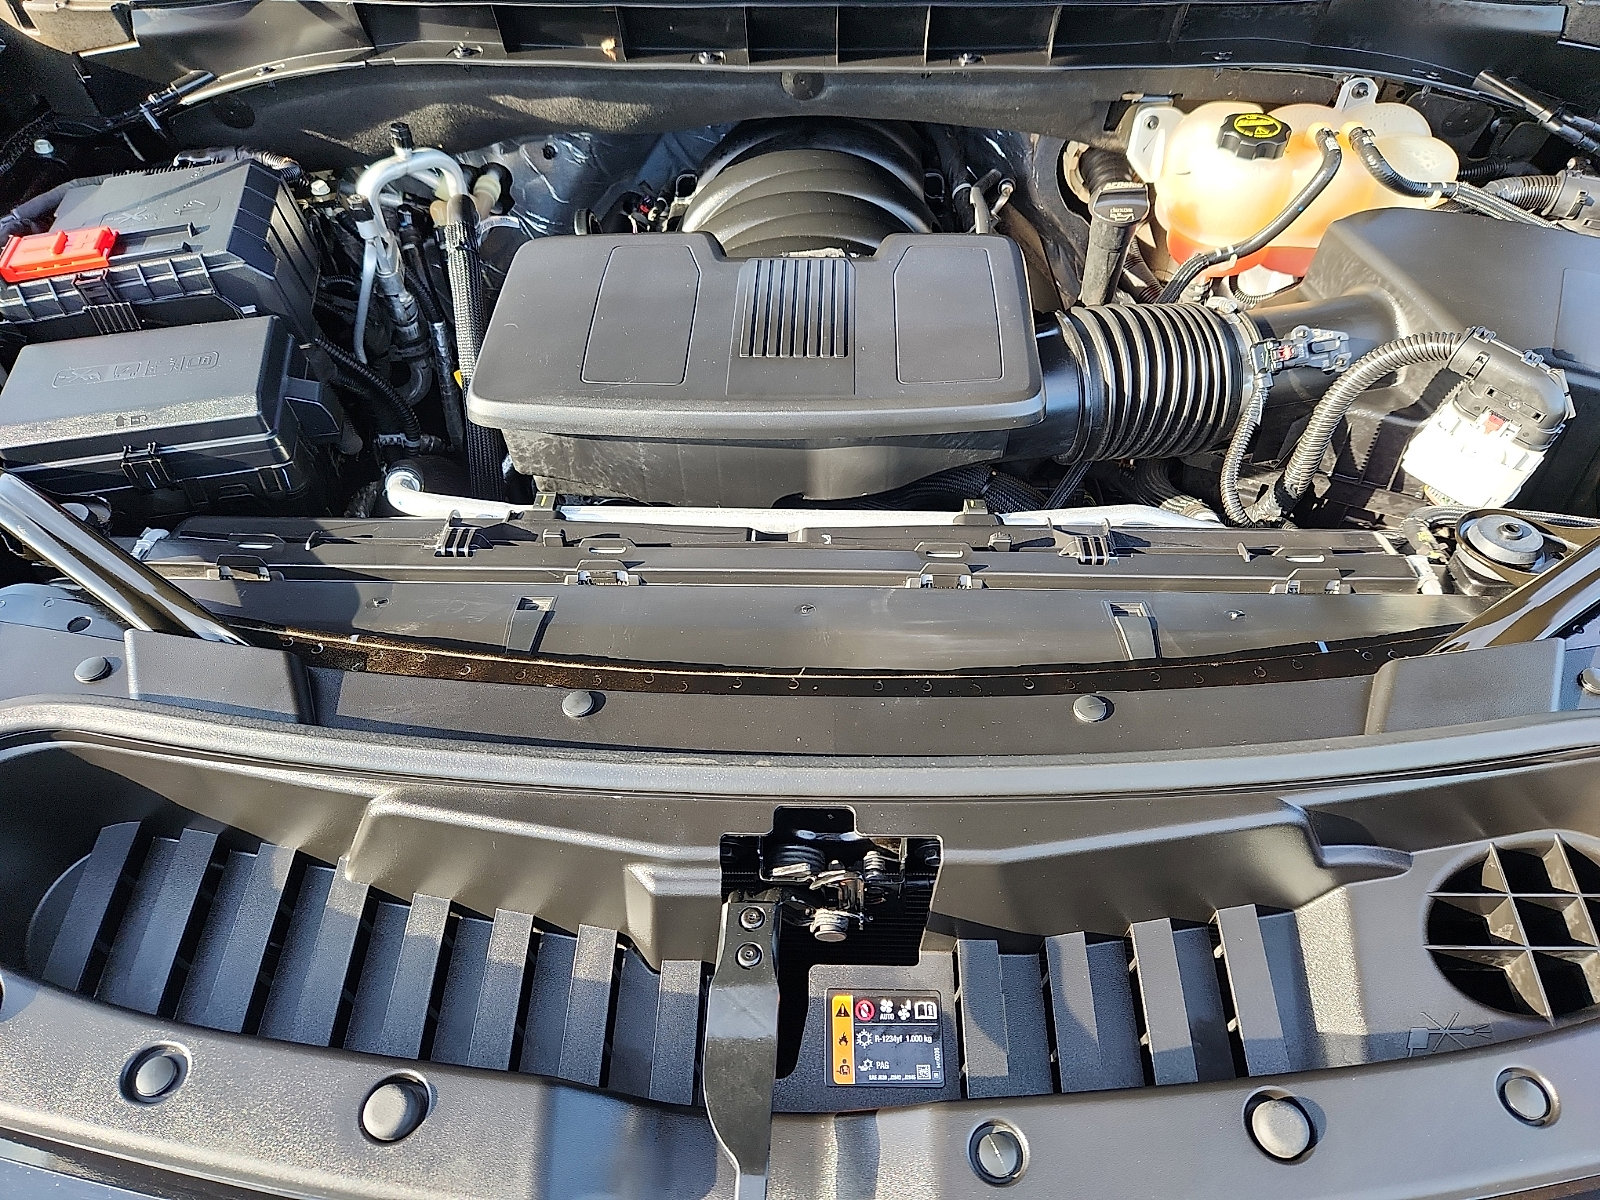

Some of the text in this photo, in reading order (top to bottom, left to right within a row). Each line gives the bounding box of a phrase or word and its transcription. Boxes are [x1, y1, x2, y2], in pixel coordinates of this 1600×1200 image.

[874, 1034, 933, 1044] R-1234yf 1.000 kg
[875, 1061, 890, 1070] PAG
